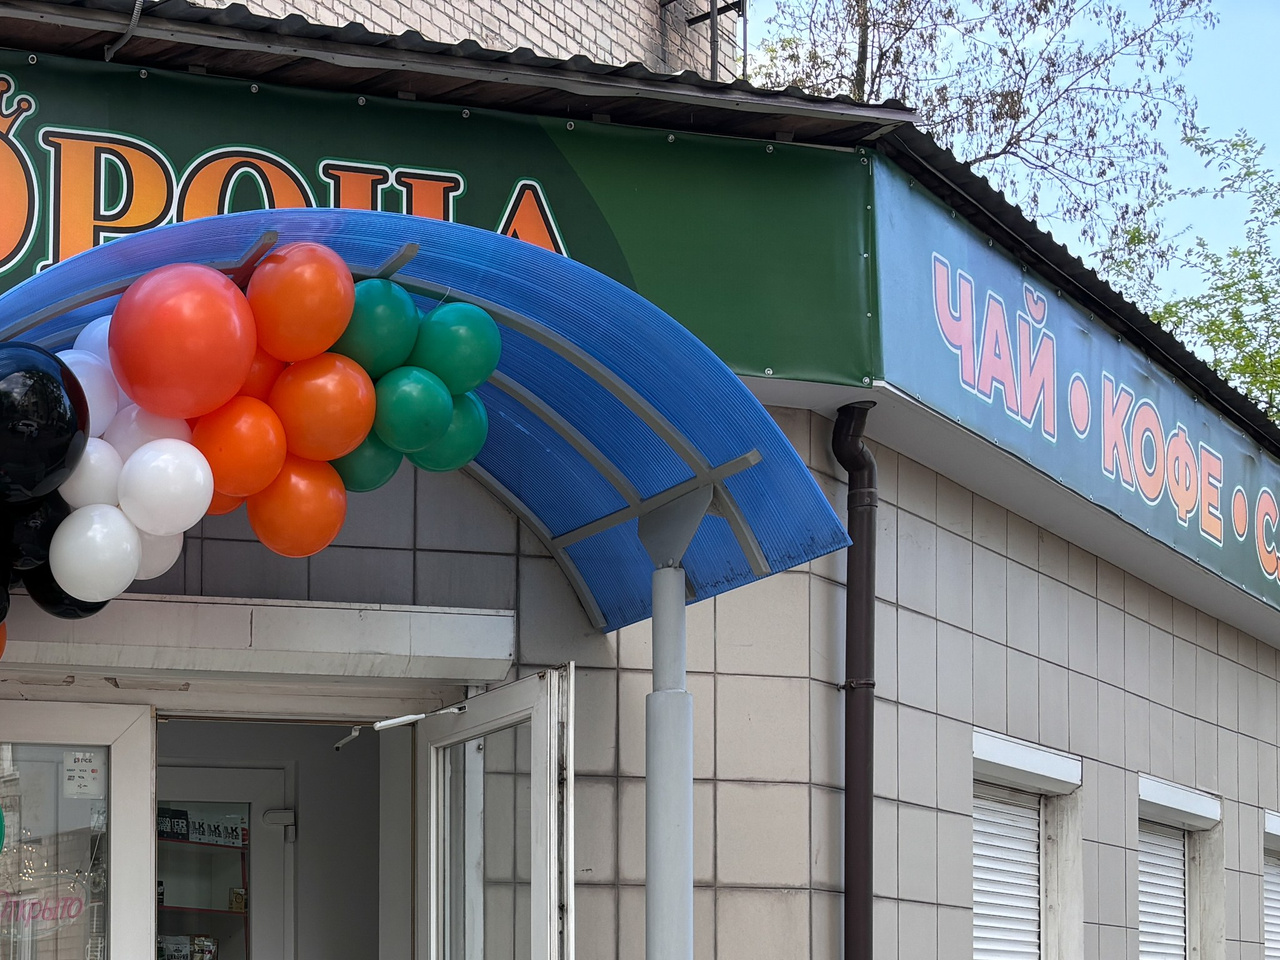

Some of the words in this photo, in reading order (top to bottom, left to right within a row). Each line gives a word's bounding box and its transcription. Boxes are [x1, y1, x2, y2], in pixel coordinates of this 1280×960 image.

[931, 250, 1057, 443] ЧАЙ
[1101, 370, 1224, 547] КОФЕ
[1255, 486, 1280, 582] С
